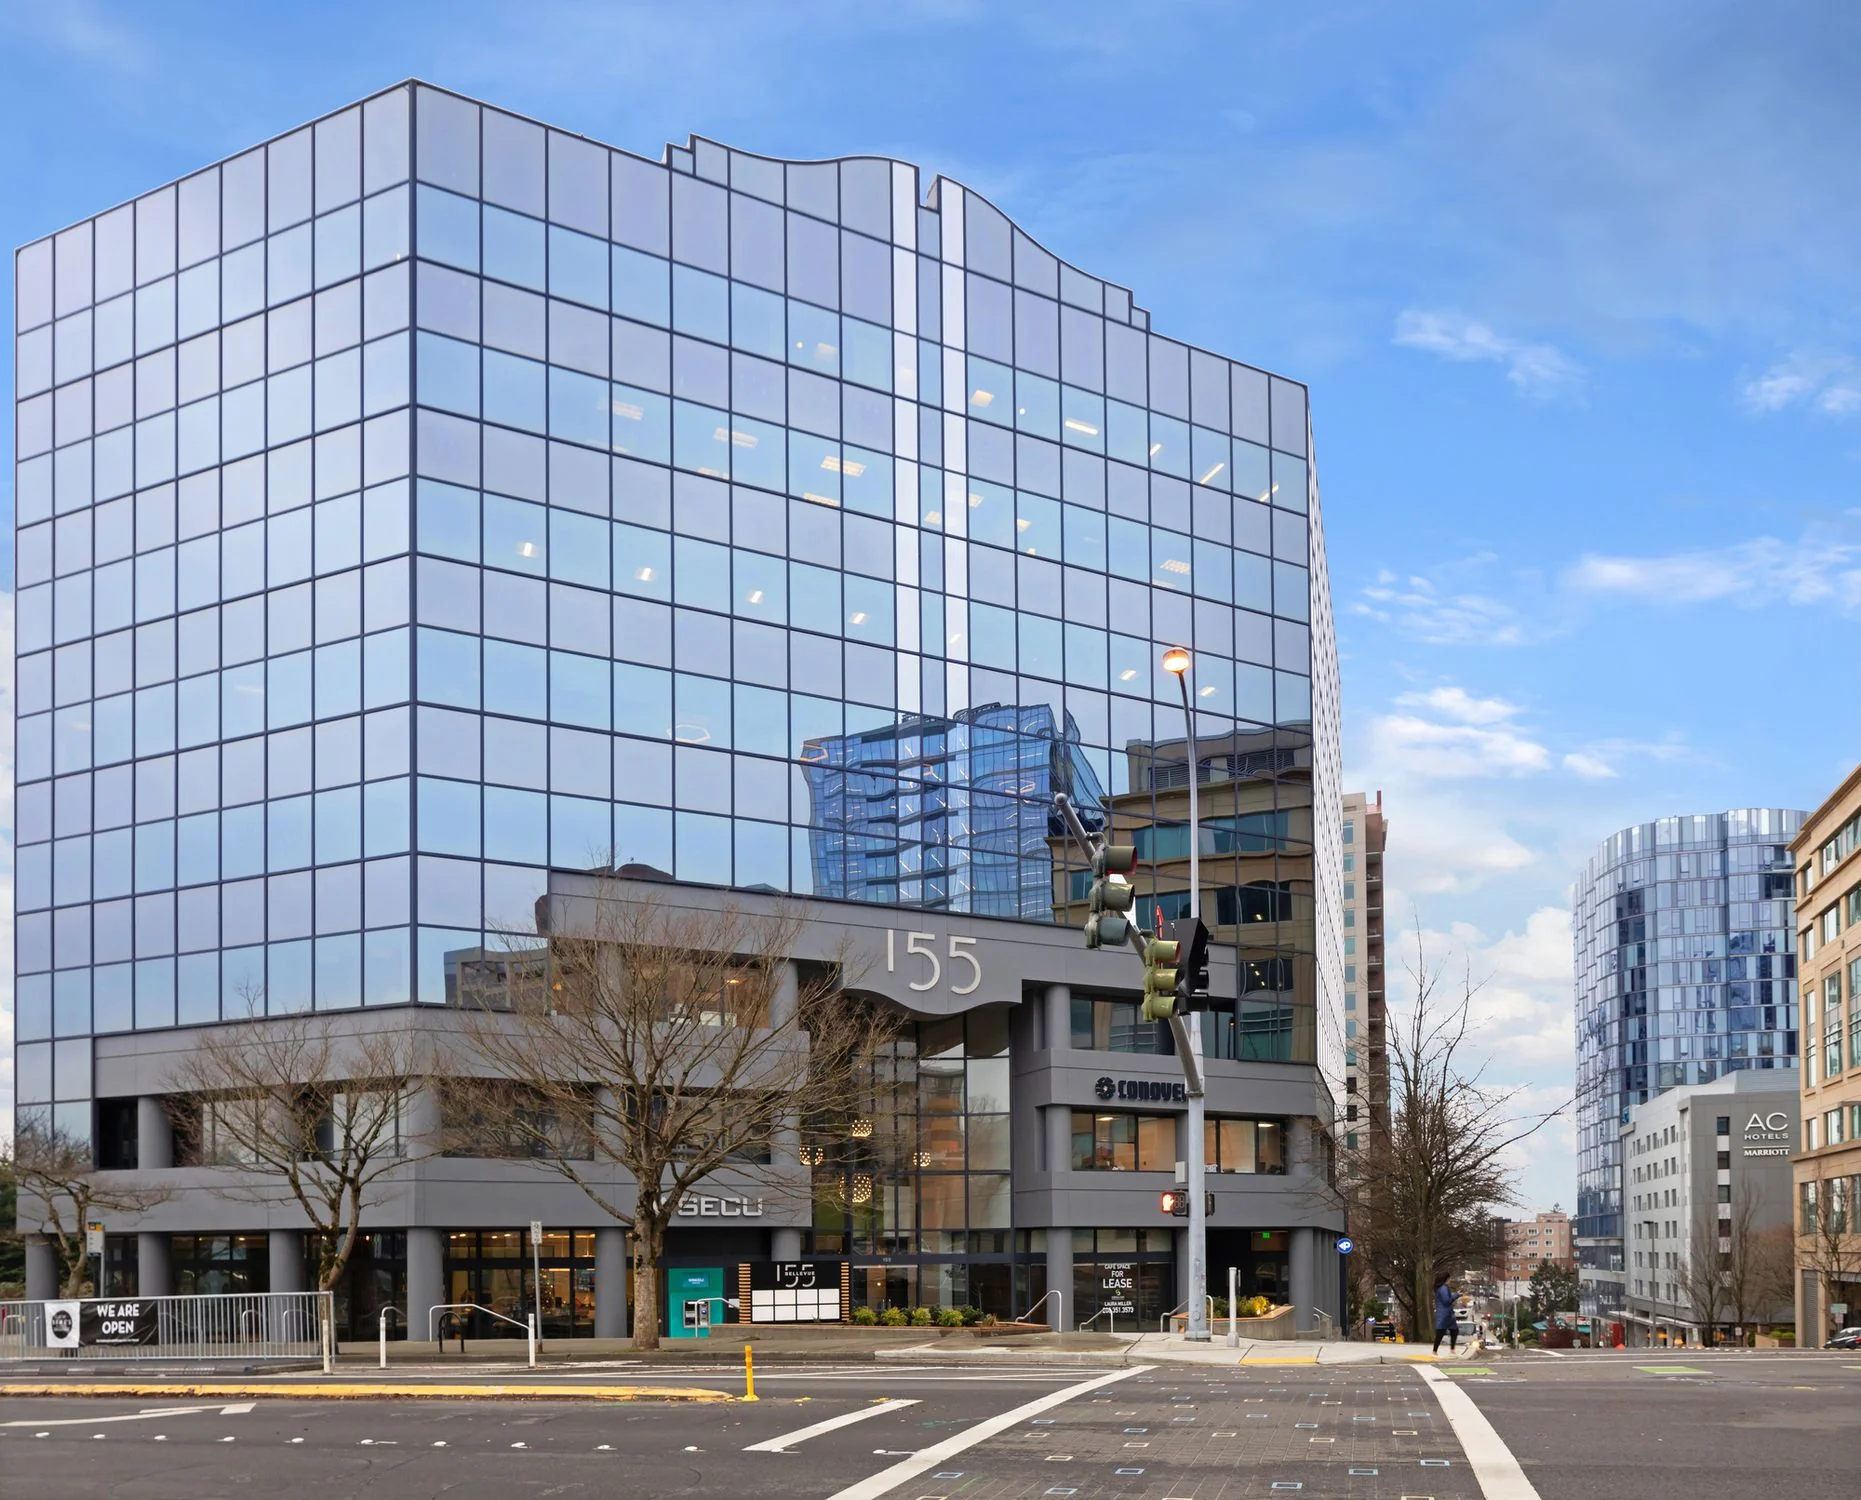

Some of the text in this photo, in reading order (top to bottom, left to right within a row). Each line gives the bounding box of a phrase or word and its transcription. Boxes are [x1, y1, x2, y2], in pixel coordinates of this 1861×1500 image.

[887, 929, 981, 995] 155
[1744, 1112, 1788, 1131] AC
[652, 1197, 763, 1217] SECU
[776, 1264, 816, 1288] 155
[1111, 1270, 1124, 1278] FOR
[1102, 1278, 1133, 1289] LEASE
[96, 1303, 140, 1317] WE ARE
[101, 1320, 135, 1334] OPEN
